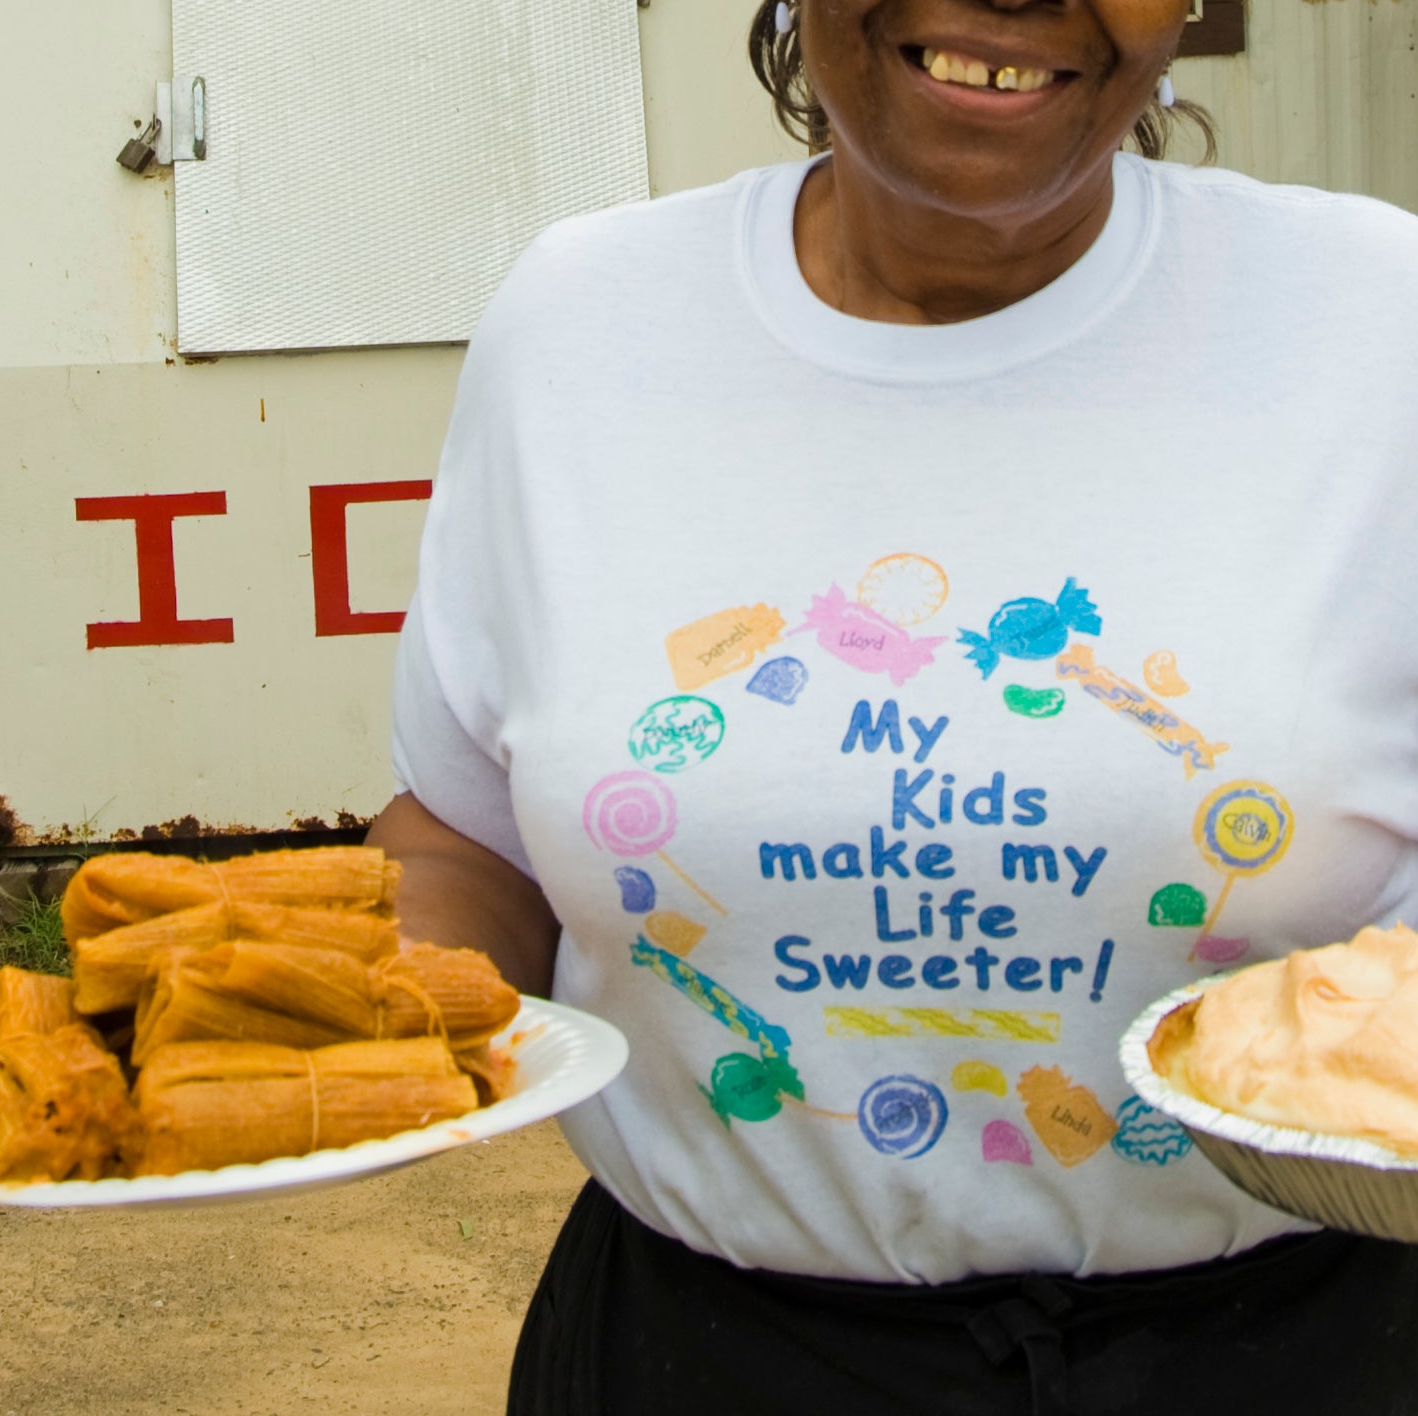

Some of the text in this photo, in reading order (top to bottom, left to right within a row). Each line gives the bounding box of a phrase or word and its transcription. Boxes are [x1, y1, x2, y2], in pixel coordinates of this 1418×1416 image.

[74, 478, 433, 651] IC
[838, 630, 886, 653] Lloyd
[840, 698, 950, 764] My
[891, 767, 1048, 831] Kids
[758, 824, 1108, 898] make my
[873, 884, 1019, 943] Life
[773, 934, 1116, 1004] Sweeter!
[1050, 1103, 1094, 1137] Linda
